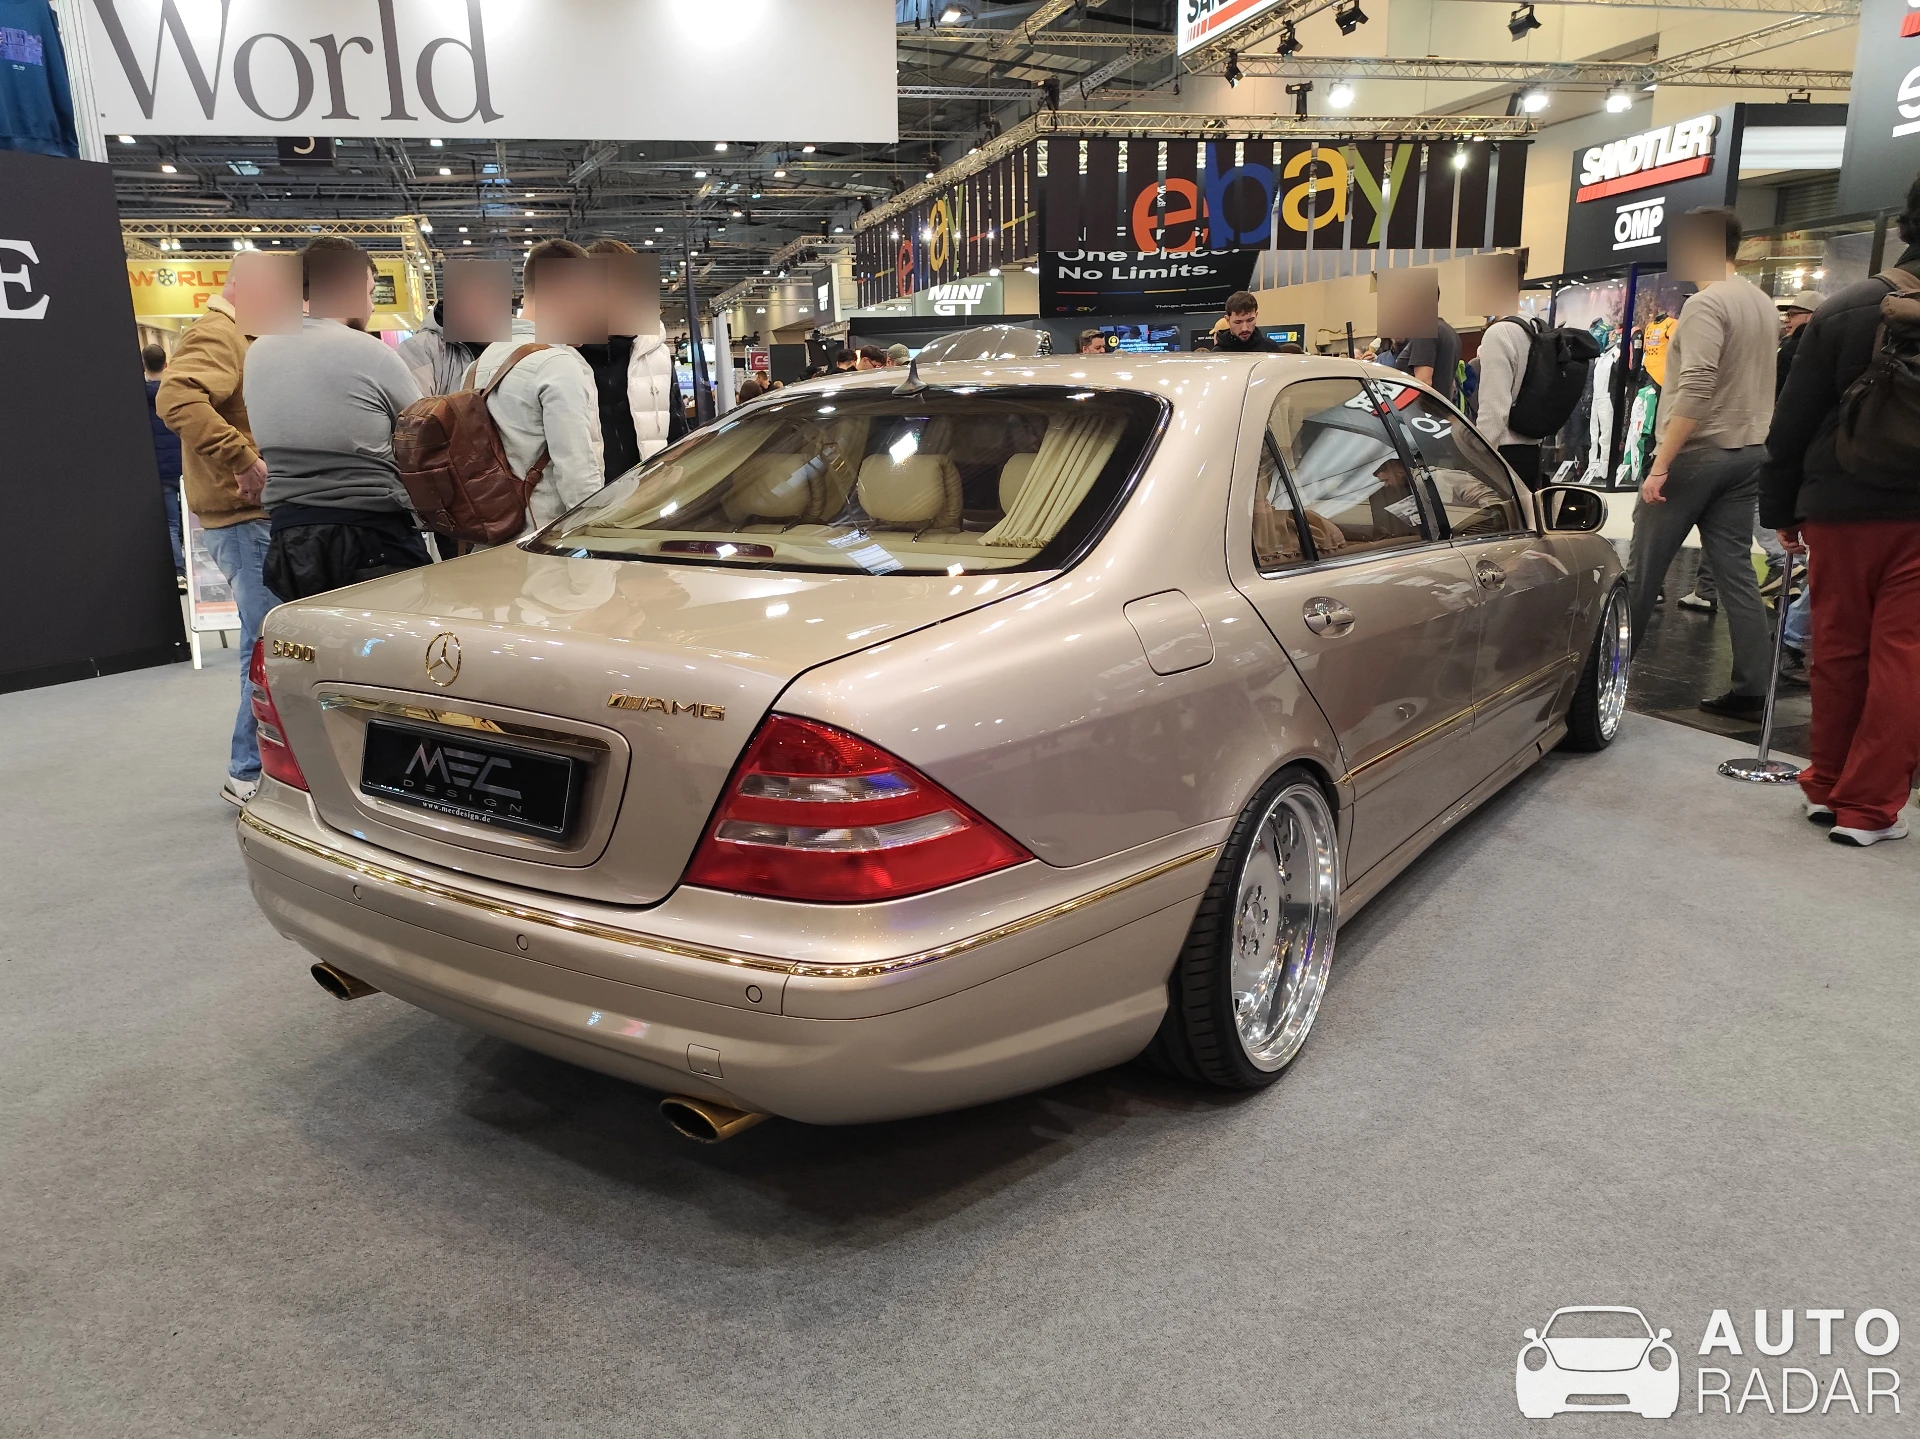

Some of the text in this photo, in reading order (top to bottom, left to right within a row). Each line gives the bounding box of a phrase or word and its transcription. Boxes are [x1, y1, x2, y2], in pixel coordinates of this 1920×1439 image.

[95, 0, 505, 124] World
[1579, 114, 1717, 186] SANDTLER
[1132, 141, 1414, 252] ebay
[1614, 205, 1665, 243] OMP
[1057, 263, 1218, 280] No Limits.
[927, 284, 985, 301] MINI
[934, 299, 981, 316] GT
[272, 639, 316, 663] S600
[642, 696, 726, 721] AMG
[405, 742, 522, 799] MEC
[403, 779, 522, 813] DESIGN
[422, 801, 491, 823] www.mecdesign.de
